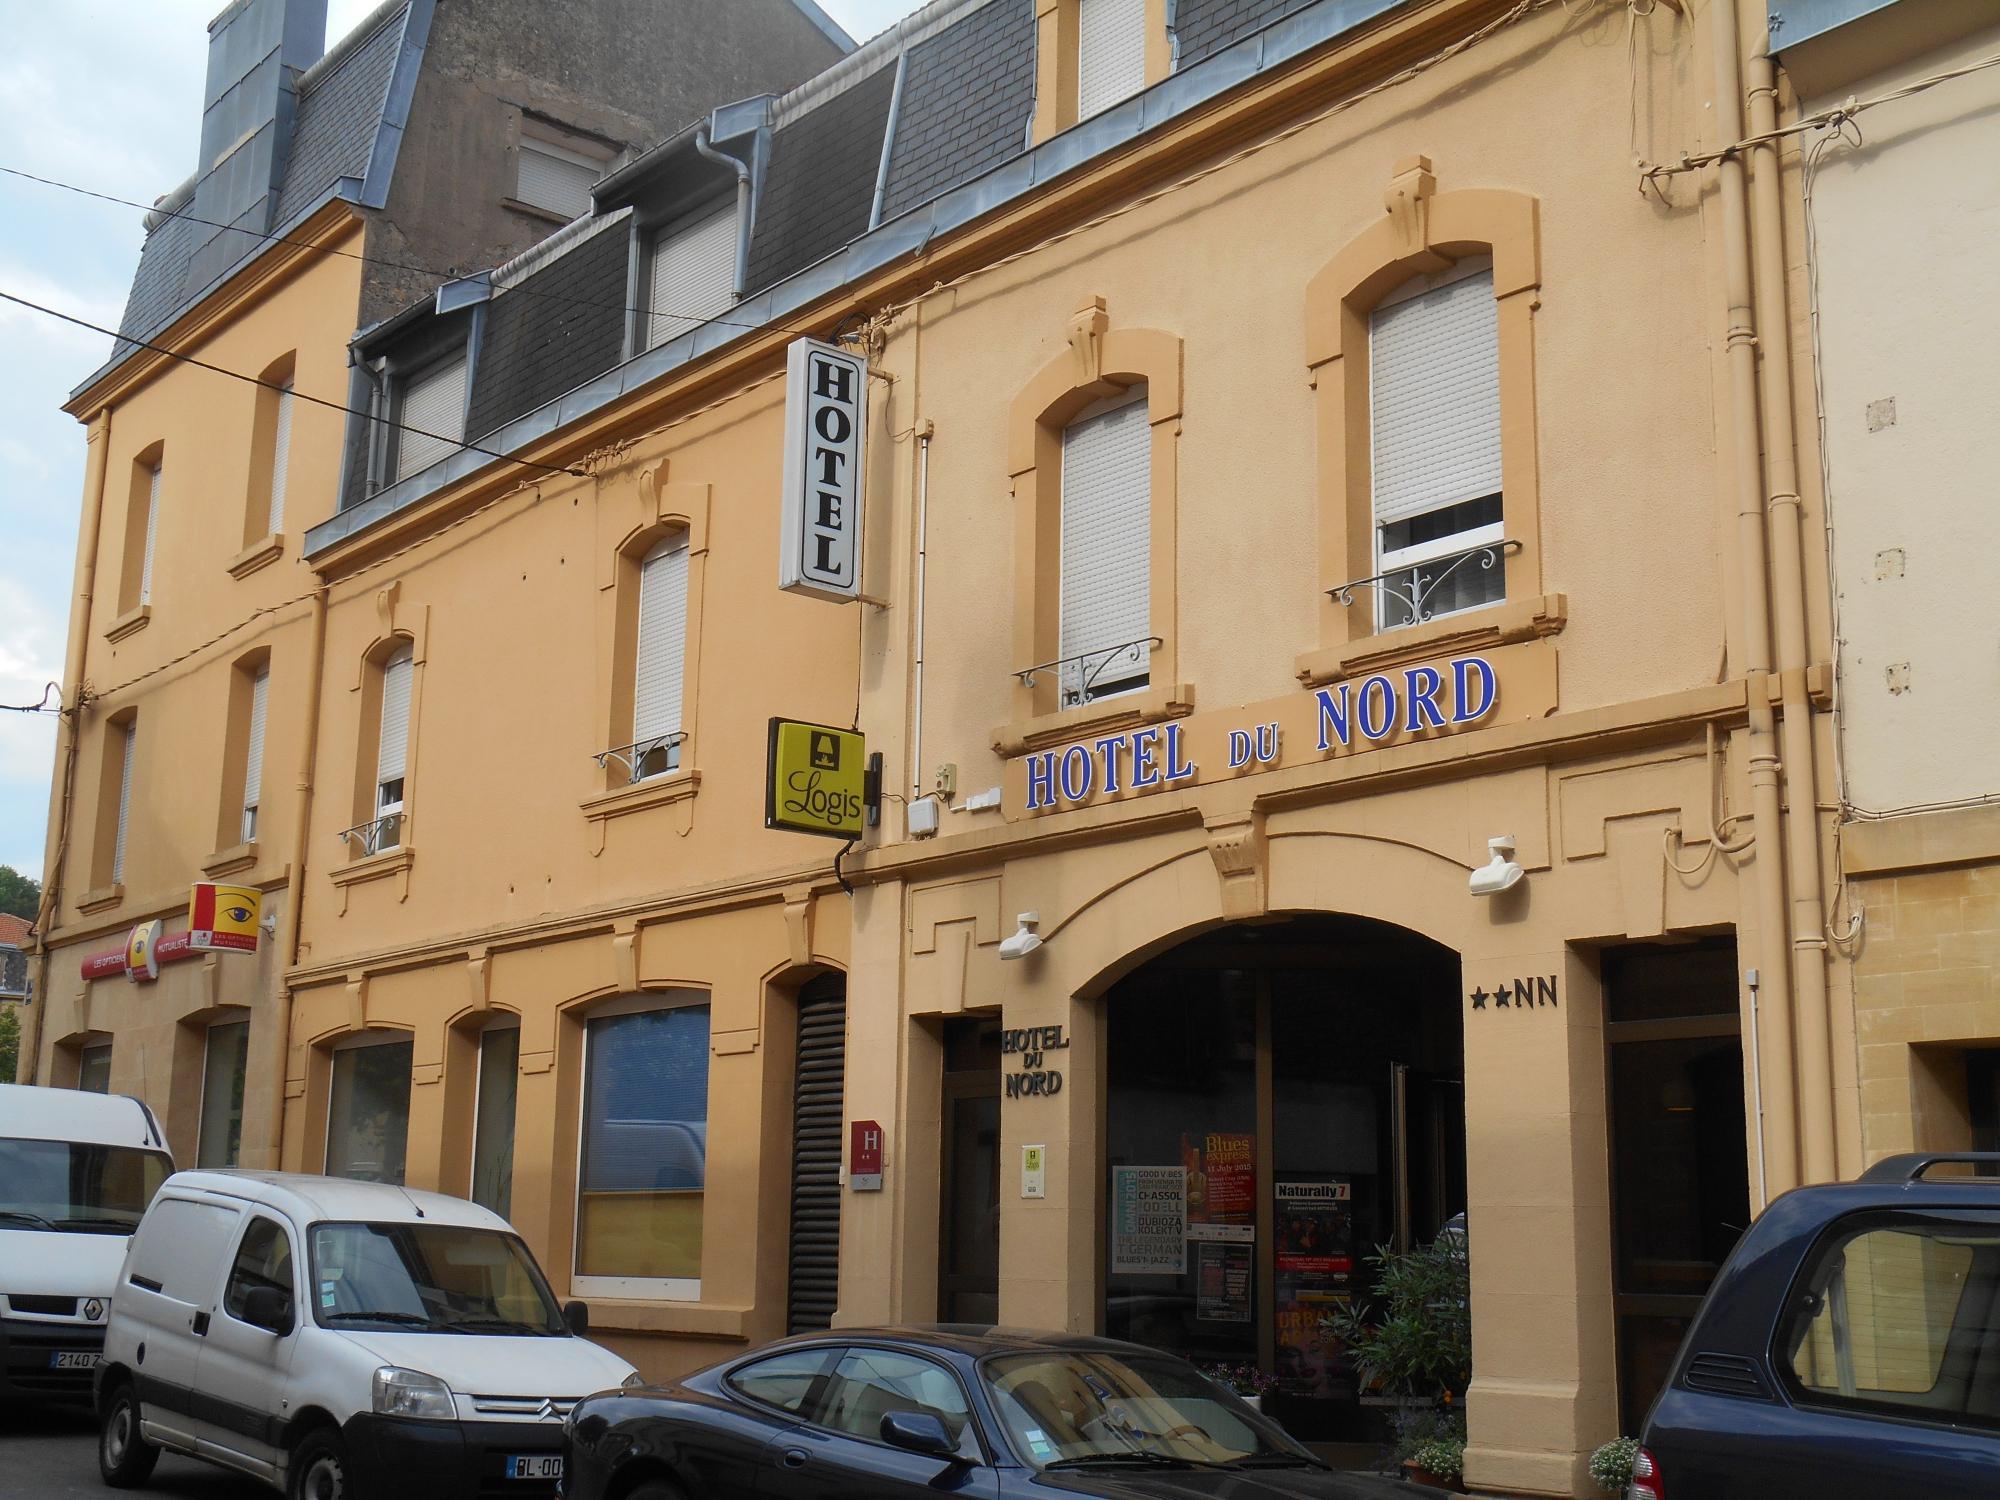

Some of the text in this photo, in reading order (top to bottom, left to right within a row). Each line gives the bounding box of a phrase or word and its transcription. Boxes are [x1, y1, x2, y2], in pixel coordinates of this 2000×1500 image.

[813, 359, 854, 575] HOTEL
[1026, 657, 1496, 809] HOTEL DU NORD
[784, 771, 860, 825] Logis
[157, 938, 189, 953] MUTUALISTE
[1001, 1025, 1069, 1053] HOTEL
[1023, 1052, 1043, 1069] DU
[1006, 1071, 1062, 1100] NORD
[864, 1131, 878, 1150] H
[1206, 1136, 1249, 1153] Blues
[1206, 1151, 1250, 1163] express
[1160, 1170, 1183, 1178] VBES
[1278, 1185, 1346, 1198] Naturally 7
[1138, 1226, 1183, 1234] KOLEKTV
[1118, 1244, 1182, 1255] TGERMAN
[58, 1354, 90, 1367] 2140
